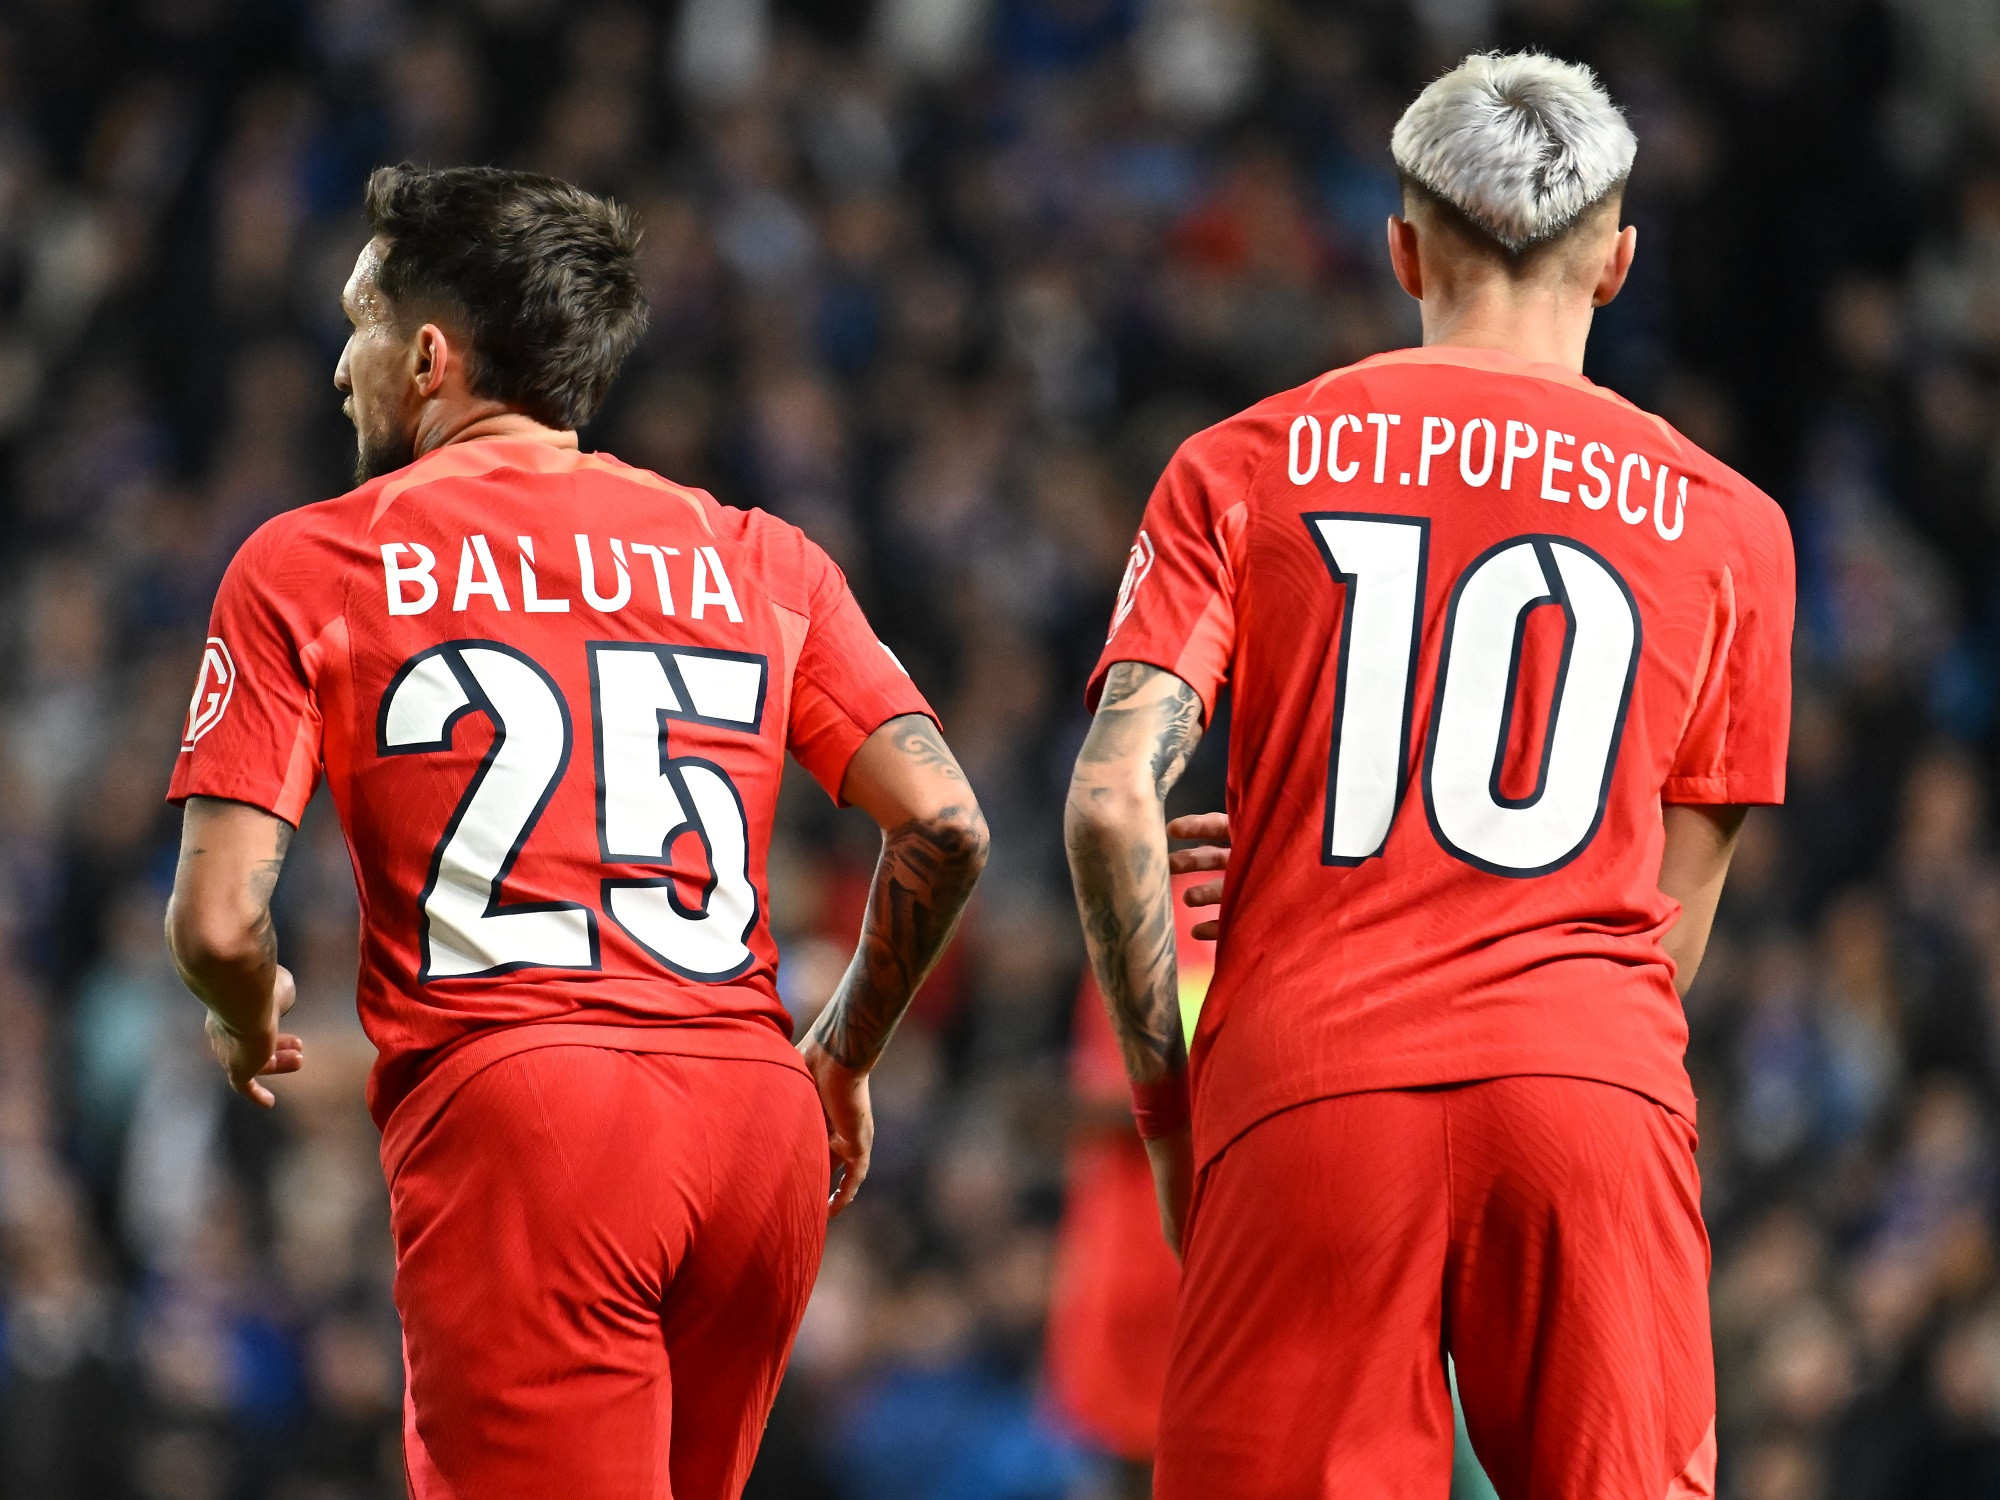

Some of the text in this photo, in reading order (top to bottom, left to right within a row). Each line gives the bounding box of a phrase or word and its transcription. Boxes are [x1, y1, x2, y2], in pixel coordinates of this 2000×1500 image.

[380, 533, 744, 623] BALUTA
[1288, 413, 1689, 541] OCT.POPESCU
[376, 638, 768, 985] 25
[1300, 511, 1643, 879] 10
